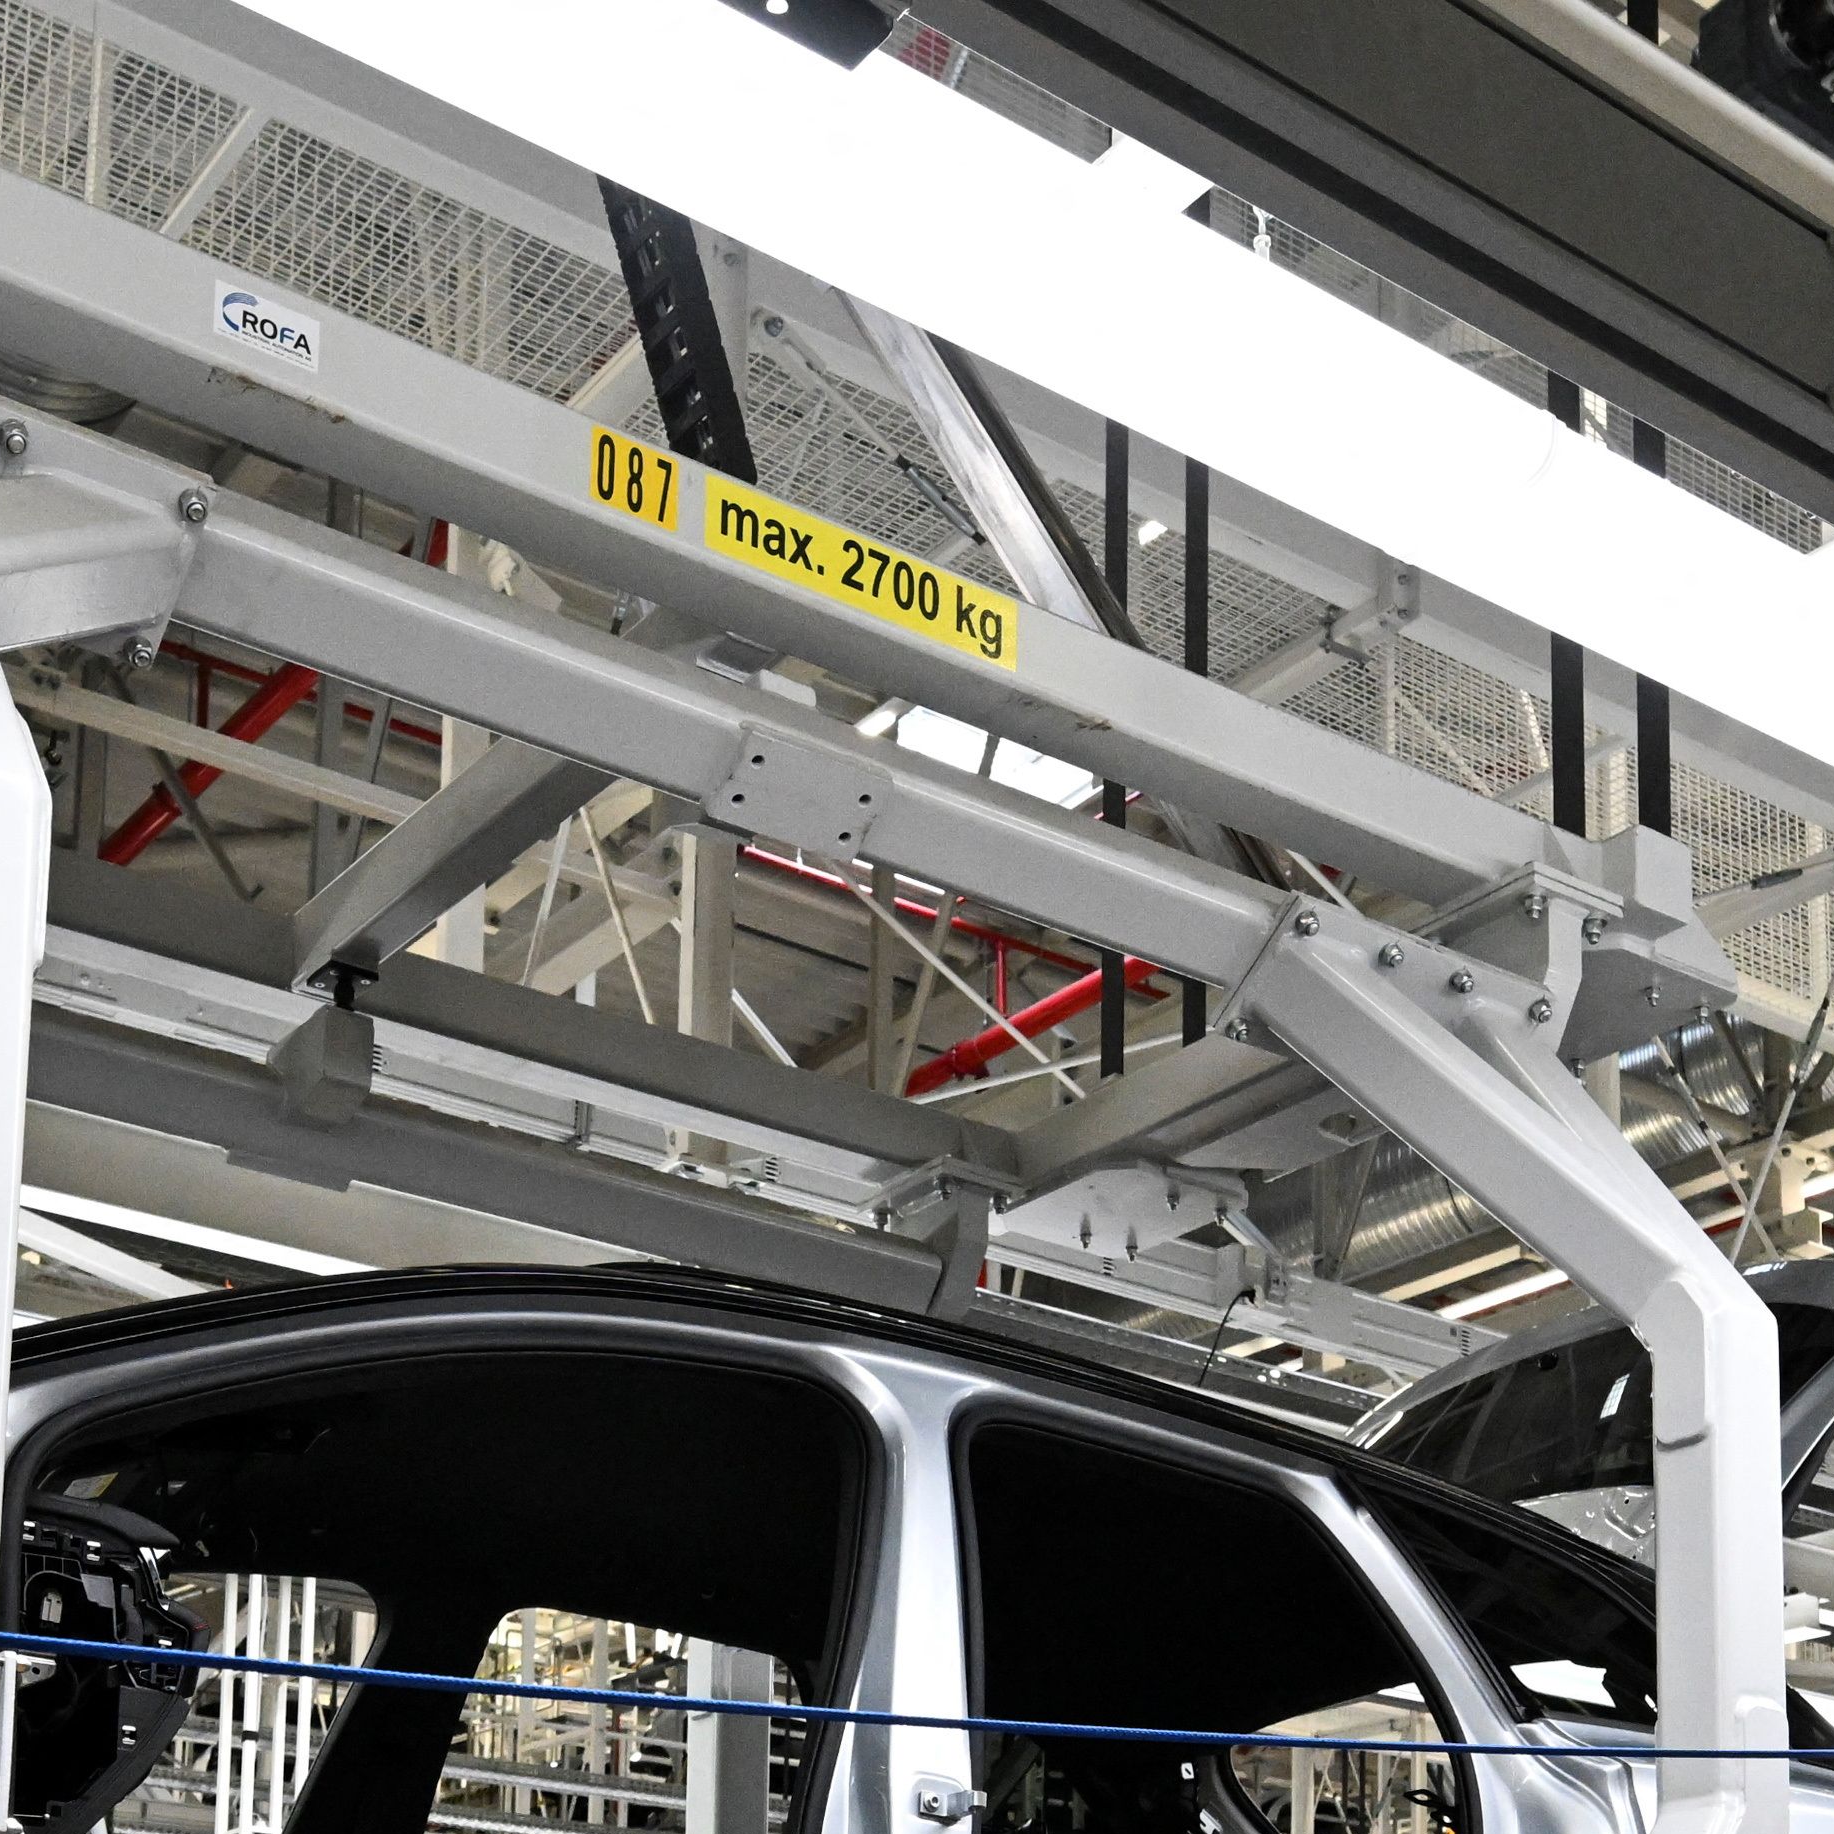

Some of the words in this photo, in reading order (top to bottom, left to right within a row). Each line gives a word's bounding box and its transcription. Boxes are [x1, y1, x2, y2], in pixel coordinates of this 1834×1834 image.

[242, 309, 311, 355] ROFA
[596, 434, 673, 523] 087
[720, 496, 827, 575] max.
[842, 540, 939, 623] 2700
[956, 586, 1004, 661] kg
